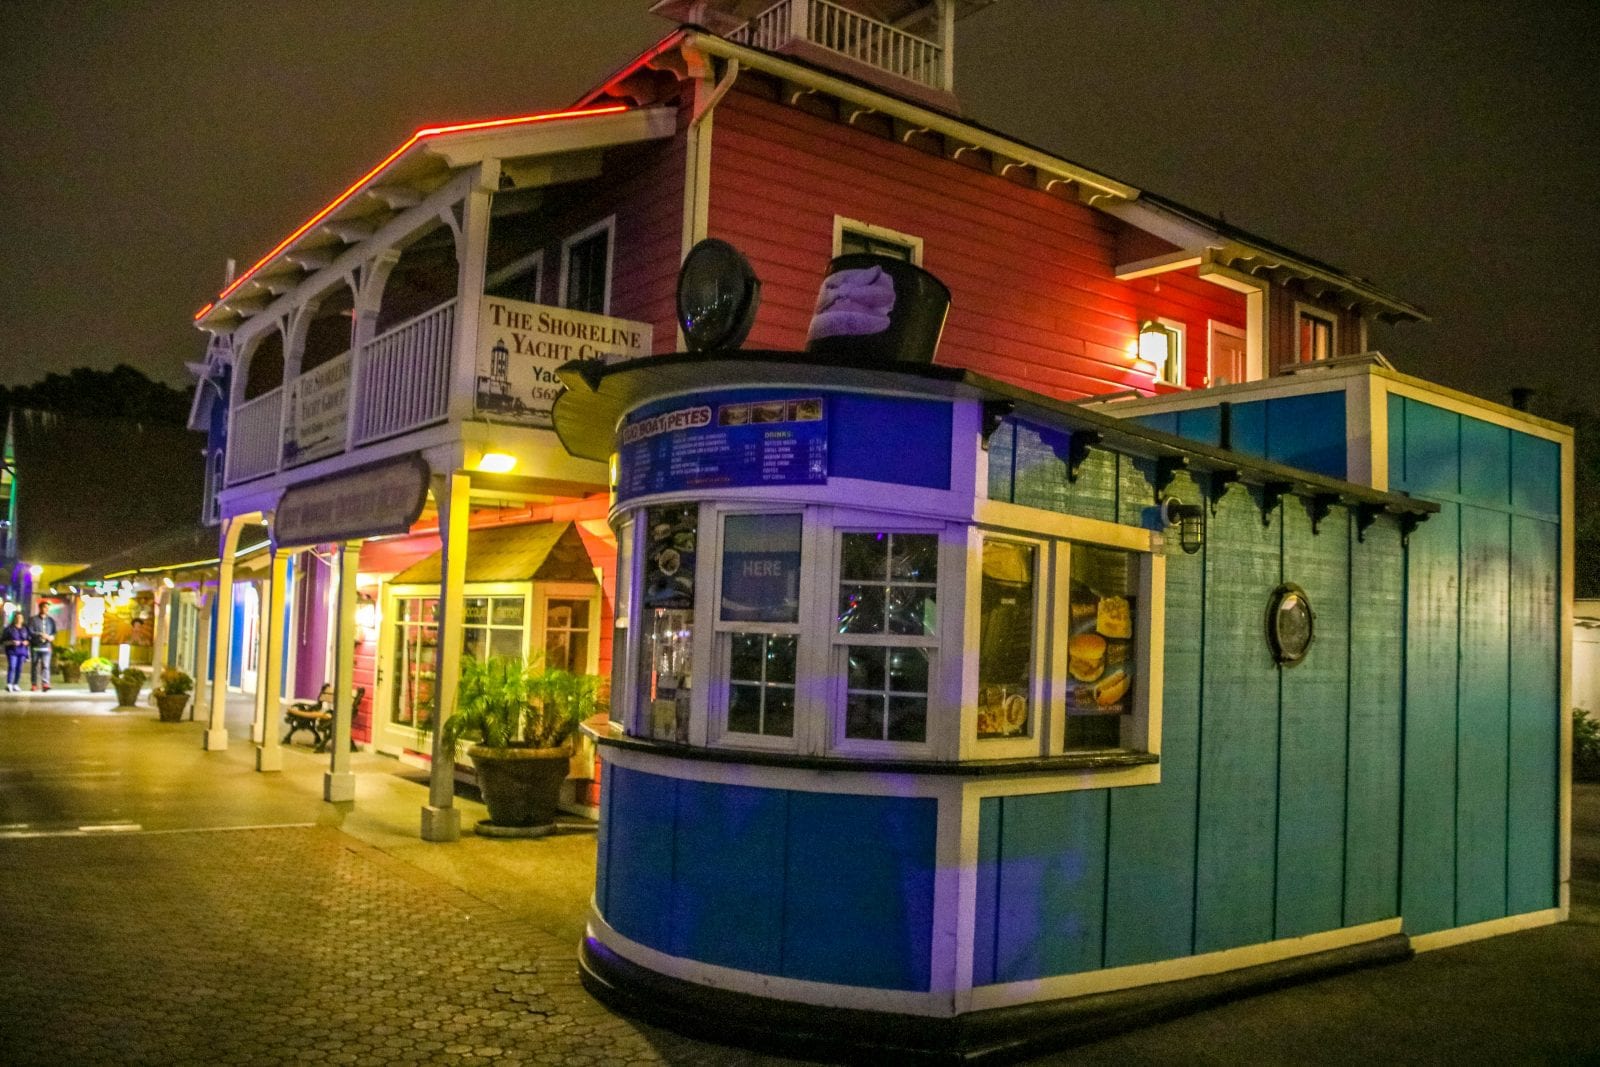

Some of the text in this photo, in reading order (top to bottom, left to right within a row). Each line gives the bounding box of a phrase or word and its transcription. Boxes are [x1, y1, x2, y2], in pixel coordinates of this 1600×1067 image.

[489, 303, 641, 349] THE SHORELINE
[511, 332, 573, 361] YACHT
[532, 365, 561, 383] Yac
[531, 387, 558, 401] (562
[667, 409, 710, 429] PETES
[742, 560, 781, 576] HERE
